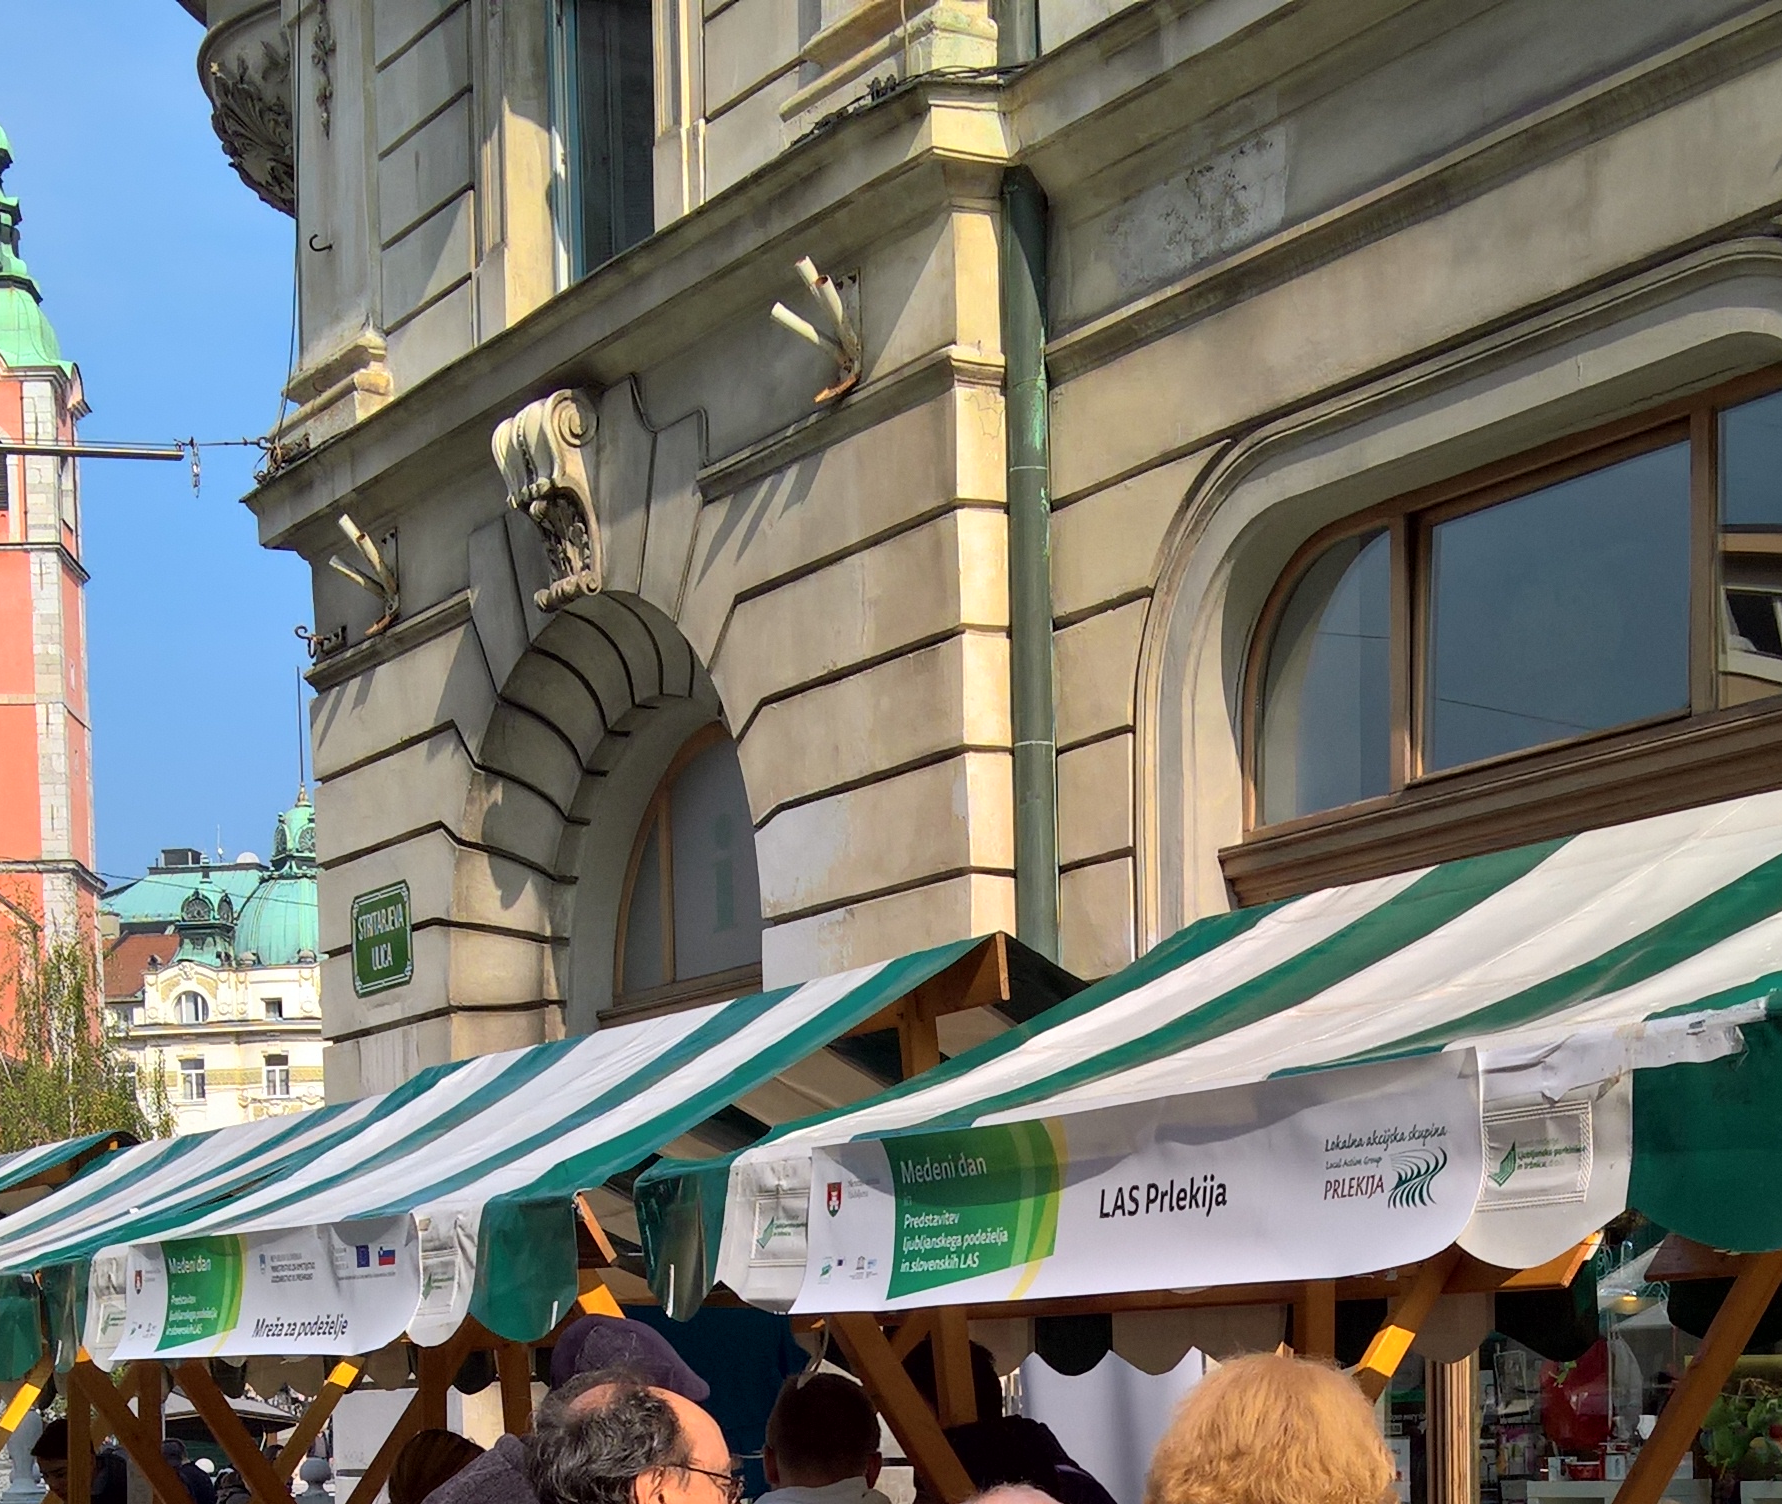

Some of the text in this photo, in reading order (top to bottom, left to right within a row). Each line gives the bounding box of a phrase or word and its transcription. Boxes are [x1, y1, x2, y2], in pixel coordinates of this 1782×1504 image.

[371, 942, 393, 971] ULICA
[1324, 1123, 1447, 1152] Lokalna akcijska skupina
[900, 1152, 987, 1185] Medeni dan
[1099, 1174, 1227, 1218] LAS Prlekija
[1324, 1174, 1384, 1200] PRLEKIJA
[903, 1211, 960, 1229] Predstavitev
[903, 1227, 1008, 1254] ljubljanskega podeželja
[911, 1253, 959, 1272] slovenskih
[960, 1252, 980, 1269] LAS
[251, 1313, 348, 1341] Mreža za podeželje
